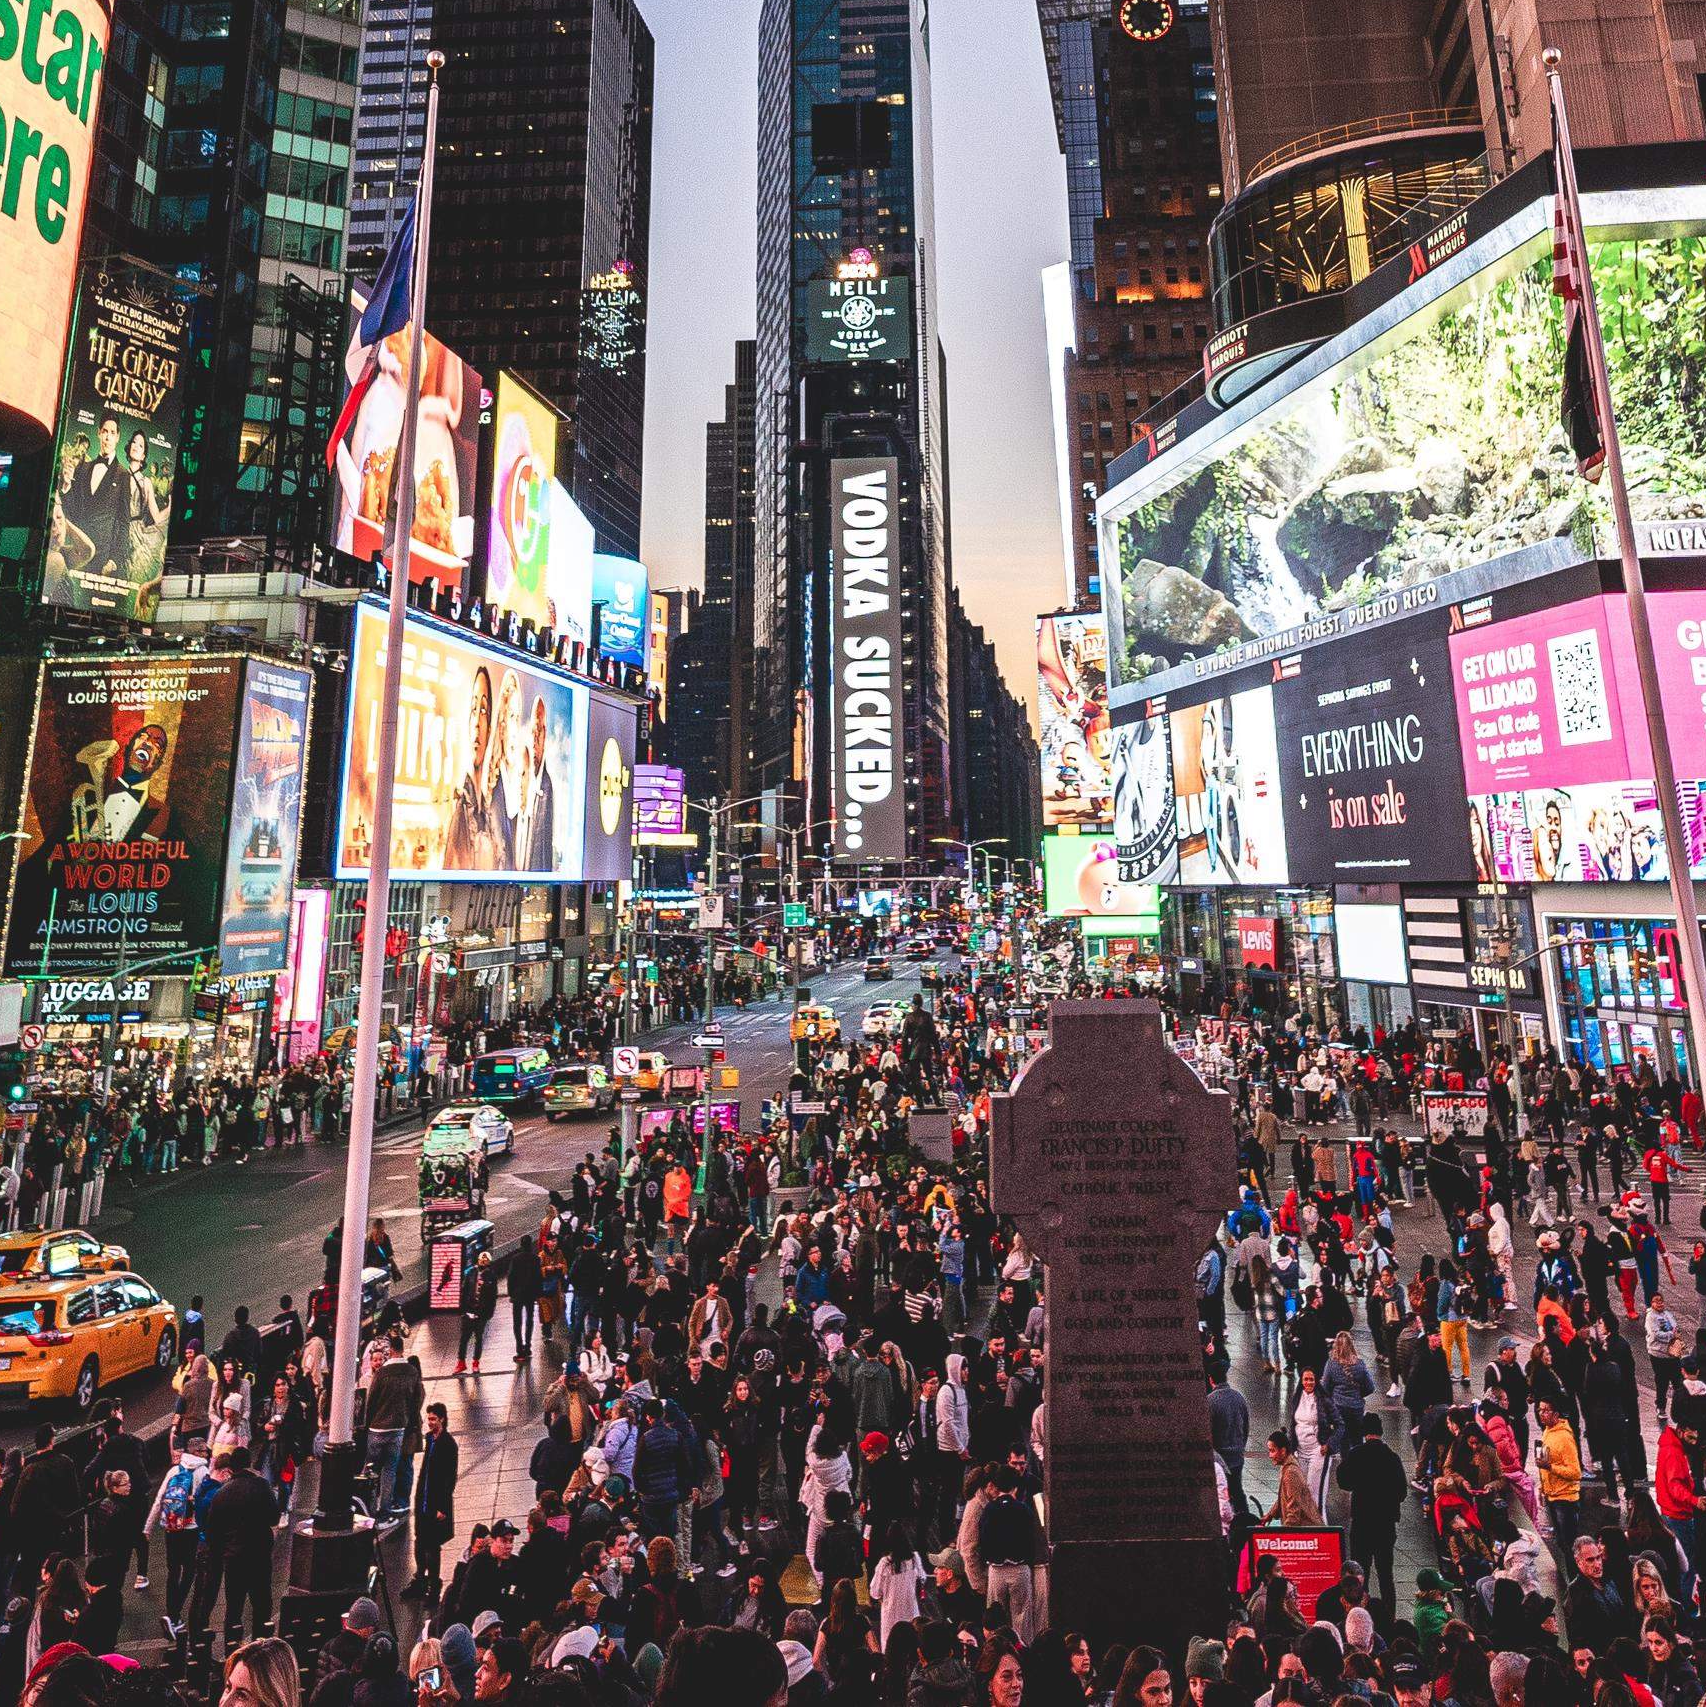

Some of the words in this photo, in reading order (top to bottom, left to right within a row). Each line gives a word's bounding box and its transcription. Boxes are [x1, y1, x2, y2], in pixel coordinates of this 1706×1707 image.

[112, 313, 167, 341] EXTRAVAGANZA
[143, 313, 181, 334] BROADWAY
[837, 330, 879, 340] VODKA
[89, 334, 121, 369] THE
[122, 346, 178, 389] GREAT
[94, 368, 166, 412] GATSBY
[125, 405, 151, 421] MUSICAL
[842, 468, 888, 621] VODKA
[1650, 527, 1675, 551] NO
[1245, 632, 1296, 660] NATIONAL
[1298, 616, 1345, 644] FOREST,
[1349, 598, 1398, 628] PUERTO
[1403, 583, 1437, 610] RICO
[1462, 654, 1486, 683] GET
[1486, 650, 1507, 677] ON
[1506, 642, 1537, 674] OUR
[111, 677, 187, 691] KNOCKOUT
[1468, 677, 1538, 714] BILLBOARD
[68, 691, 108, 704] LOUIS
[1473, 719, 1498, 739] Scan
[1514, 711, 1541, 732] code
[842, 635, 892, 849] SUCKED...
[1301, 714, 1424, 778] EVERYTHING
[1506, 734, 1544, 759] started
[1327, 788, 1344, 829] is
[1347, 794, 1369, 827] on
[1372, 779, 1407, 824] sale
[49, 844, 64, 861] A
[68, 841, 189, 861] WONDERFUL
[64, 864, 170, 889] WORLD
[88, 891, 158, 914] LOUIS
[37, 918, 148, 934] ARMSTRONG
[74, 942, 113, 950] PREVIEWS
[140, 941, 177, 949] OCTOBER
[1255, 1536, 1319, 1553] Welcome!
